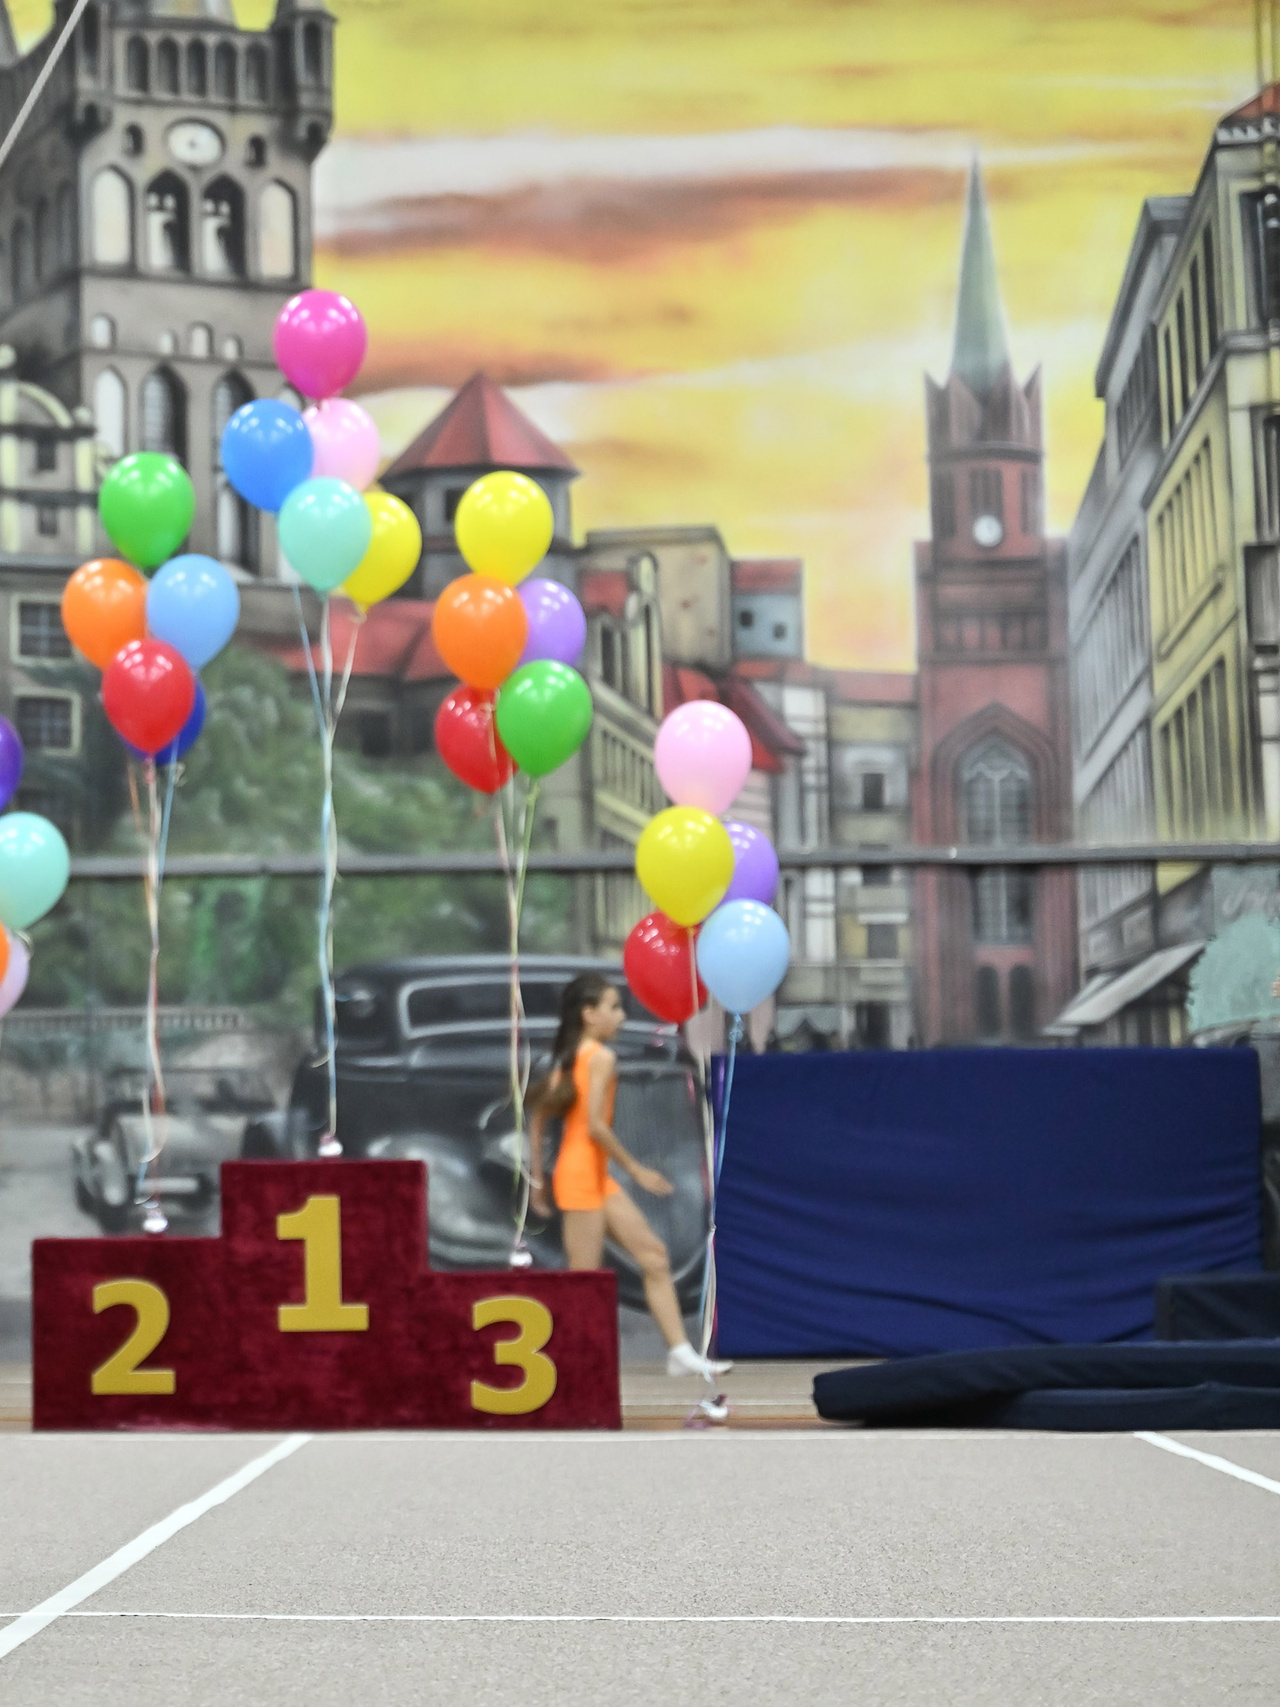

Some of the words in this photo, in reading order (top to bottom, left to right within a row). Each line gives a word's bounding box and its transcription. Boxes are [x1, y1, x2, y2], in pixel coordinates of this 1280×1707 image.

[276, 1195, 369, 1332] 1
[91, 1278, 176, 1395] 2
[470, 1295, 557, 1415] 3
